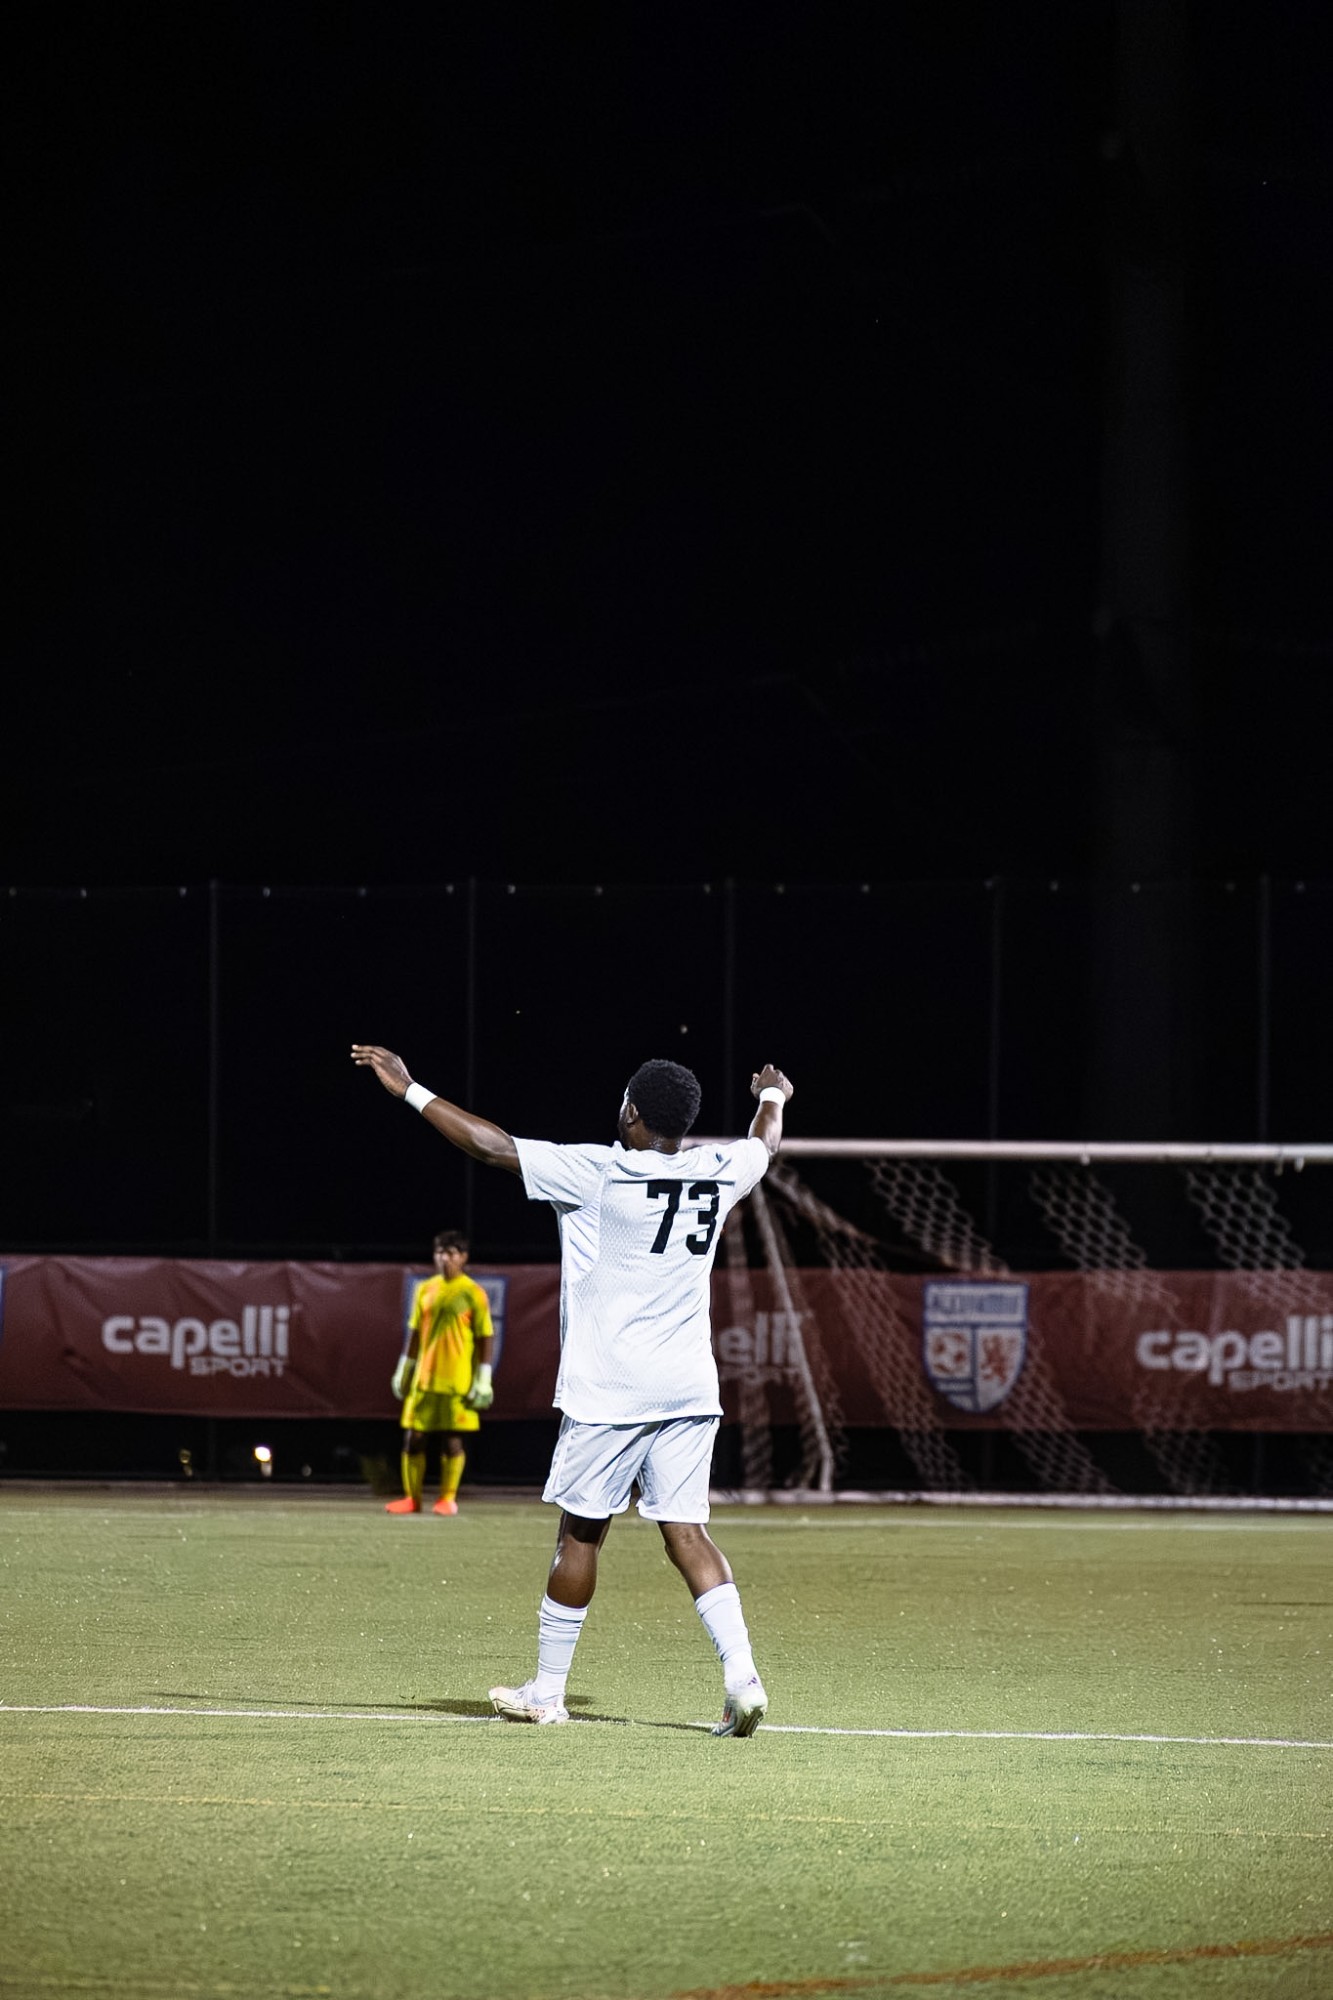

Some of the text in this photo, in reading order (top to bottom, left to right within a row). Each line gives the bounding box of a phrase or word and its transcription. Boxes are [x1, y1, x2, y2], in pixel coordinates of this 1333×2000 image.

[646, 1179, 720, 1256] 73
[102, 1304, 290, 1371] capelli
[189, 1355, 287, 1378] SPORT
[718, 1311, 803, 1366] elli
[1136, 1314, 1333, 1387] capelli
